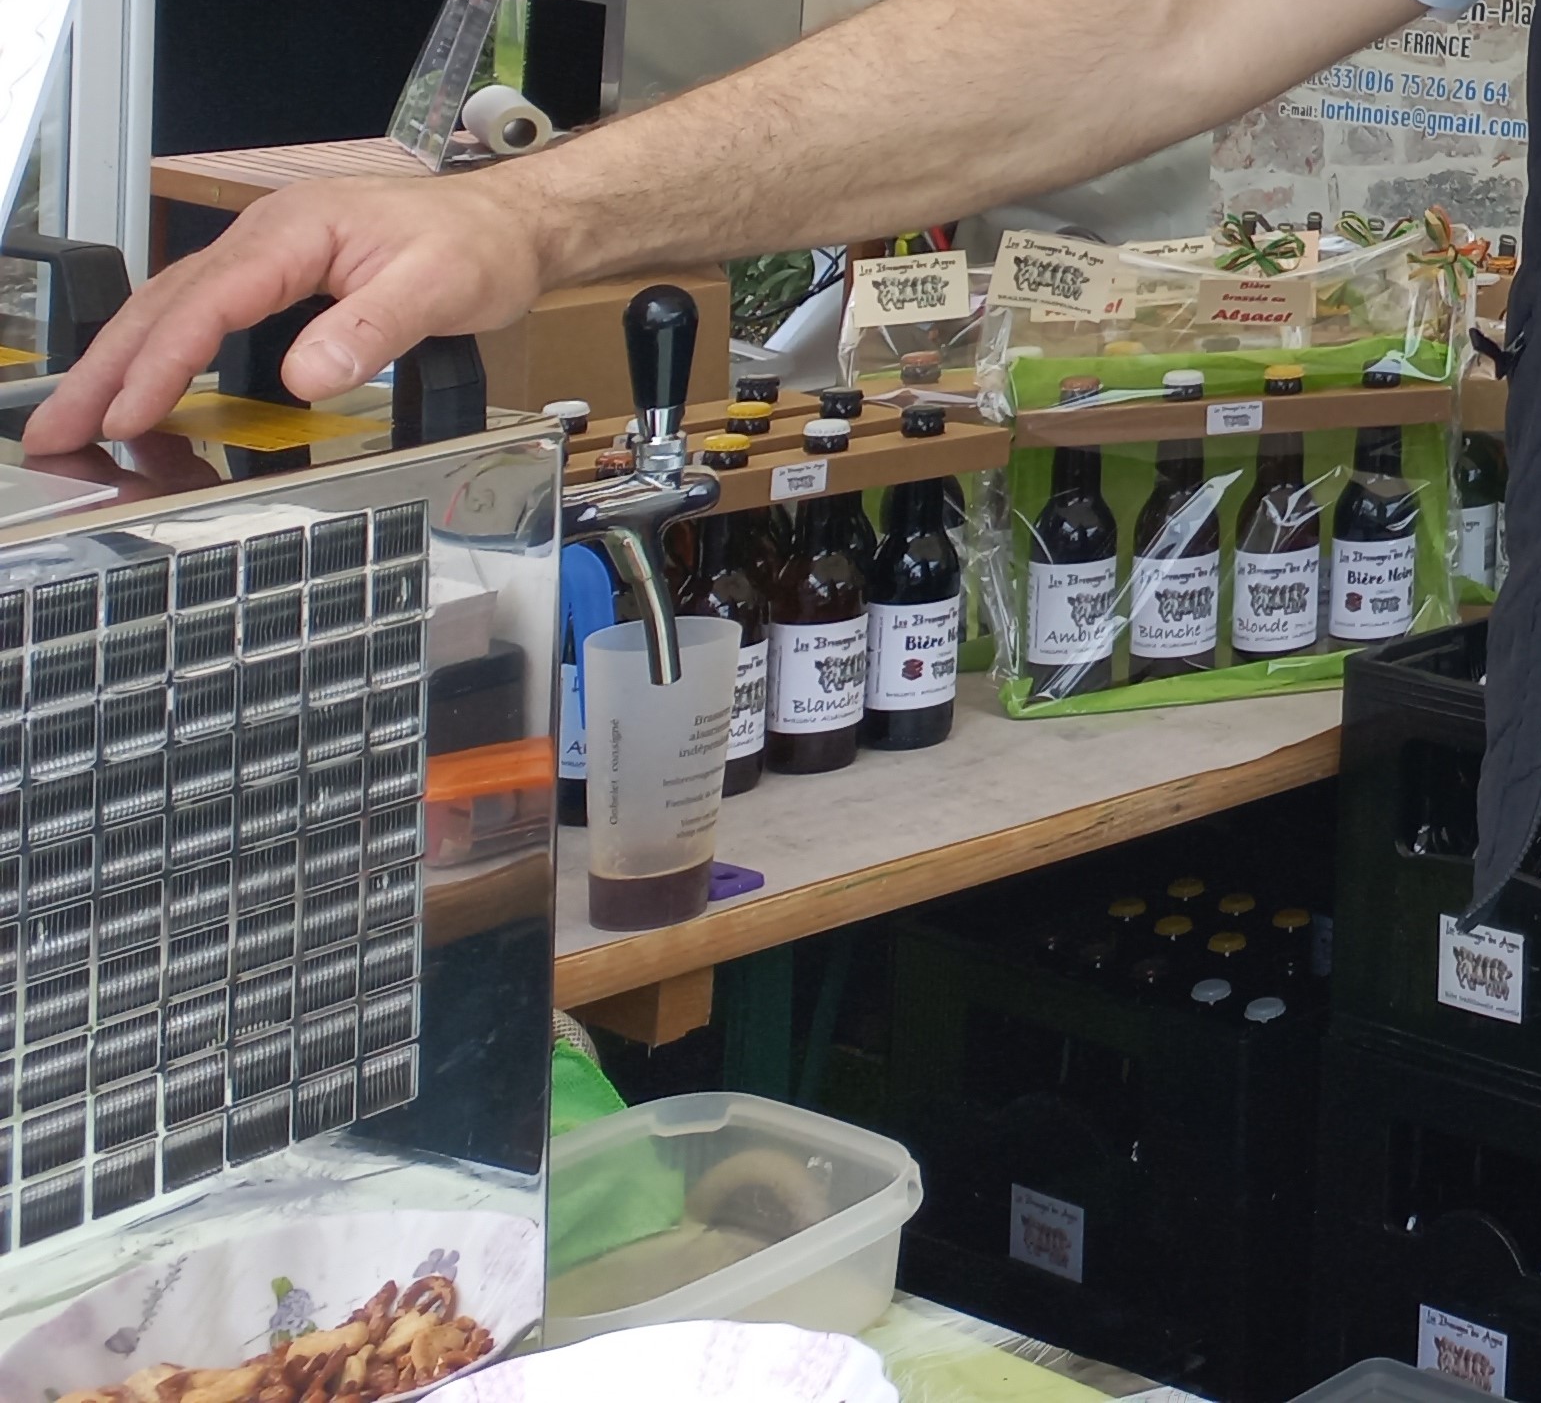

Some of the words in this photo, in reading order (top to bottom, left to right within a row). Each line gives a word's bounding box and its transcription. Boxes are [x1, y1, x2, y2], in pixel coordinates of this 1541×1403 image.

[1403, 32, 1472, 58] FRANCE
[1322, 68, 1352, 88] +33
[1358, 69, 1394, 93] (0)6
[1401, 73, 1420, 95] 75
[1425, 77, 1446, 98] 26
[1453, 78, 1476, 100] 26
[1484, 81, 1508, 103] 64
[1280, 104, 1318, 117] e-mail:
[1321, 99, 1527, 138] lorhinoise@gmail.com
[1211, 308, 1293, 324] Alsace!
[1138, 624, 1201, 639] Blanche
[1236, 618, 1290, 634] Blonde
[905, 635, 946, 651] Bière
[792, 691, 859, 714] Blanche
